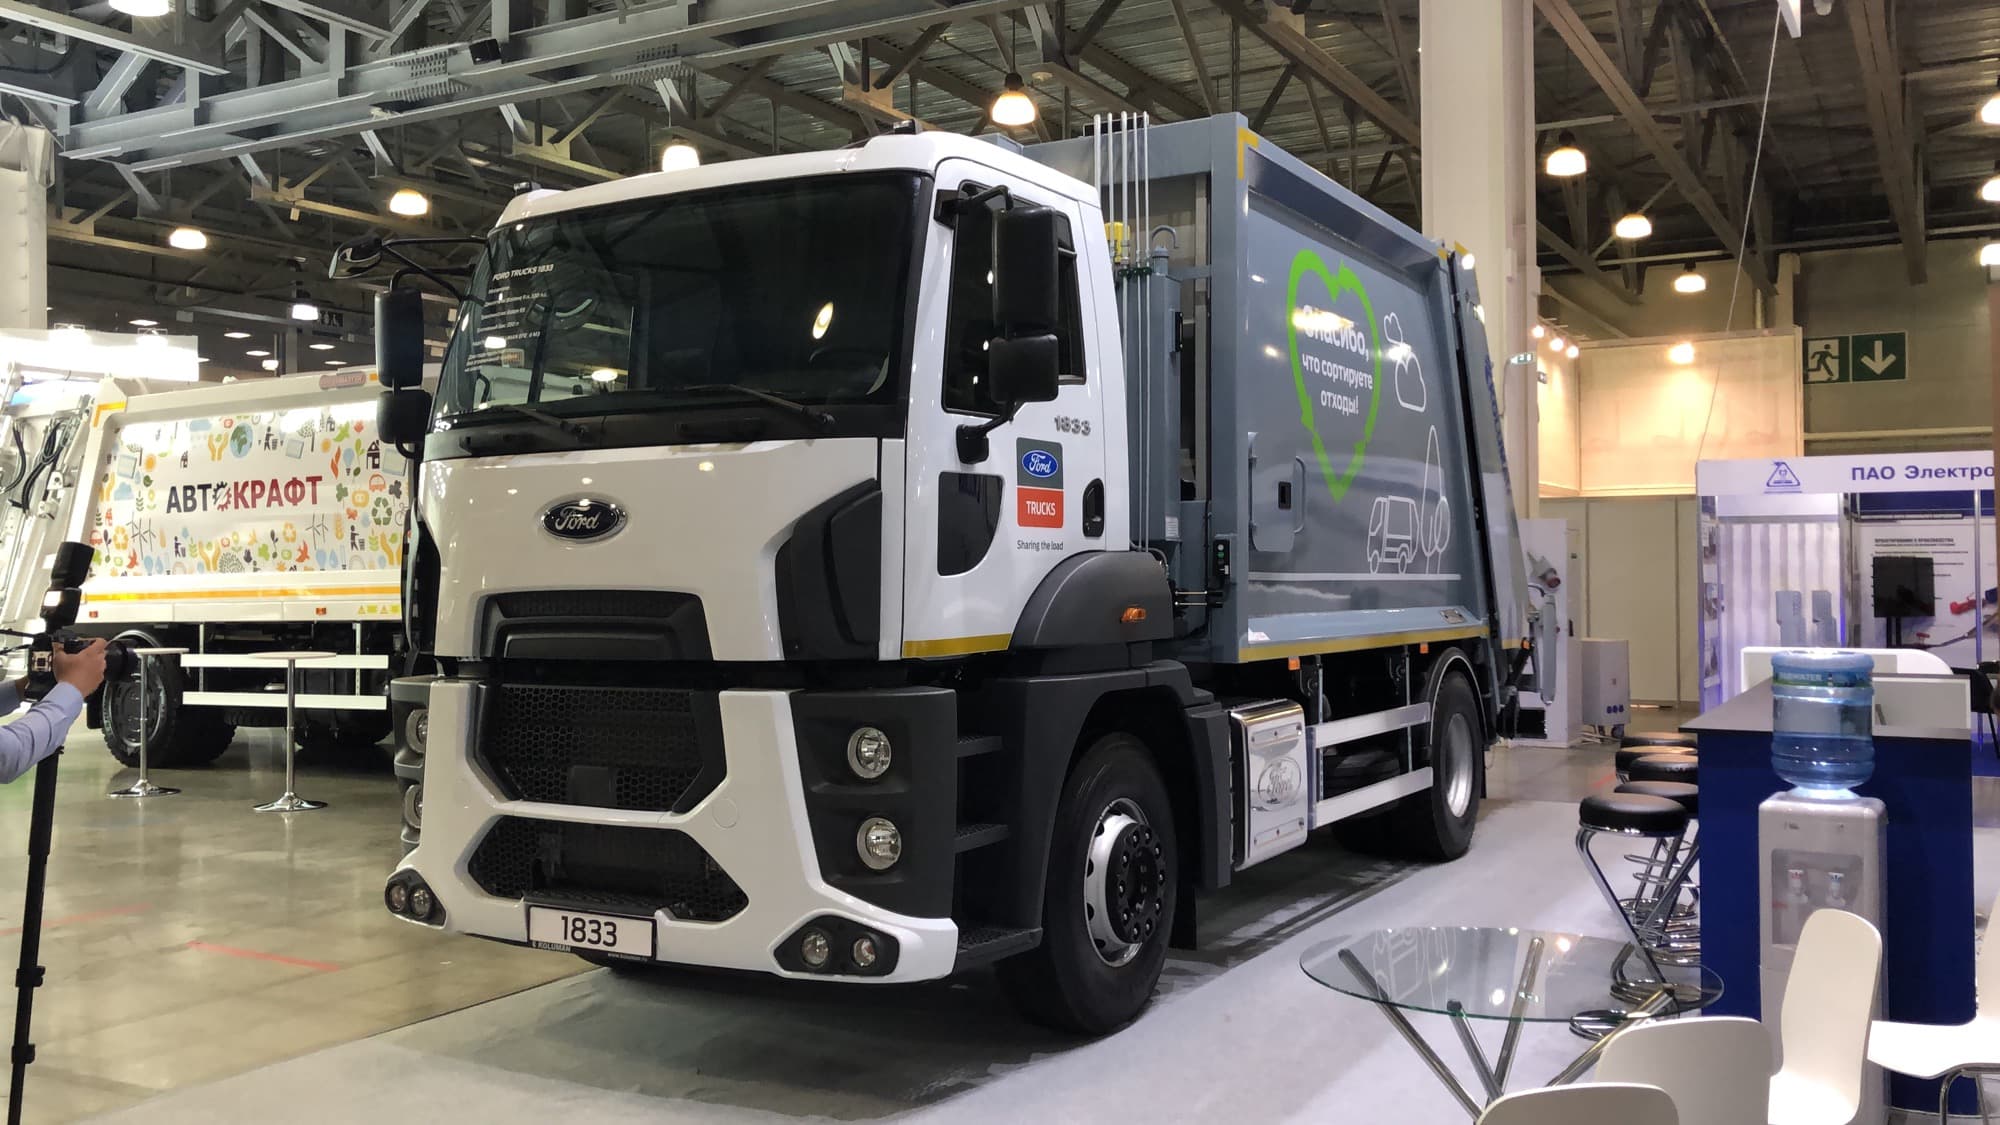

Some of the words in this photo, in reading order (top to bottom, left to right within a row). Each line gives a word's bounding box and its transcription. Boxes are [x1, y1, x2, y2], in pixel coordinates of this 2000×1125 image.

[492, 271, 511, 281] FORD
[511, 266, 537, 277] TRUCKS
[1302, 353, 1320, 374] что
[1321, 360, 1373, 389] сортируете
[1320, 390, 1359, 417] отходы!
[1054, 415, 1091, 437] 1833
[1029, 453, 1052, 473] Ford
[1851, 466, 1896, 481] ПАО
[1904, 465, 1995, 480] Электро
[555, 506, 601, 530] Ford
[1026, 500, 1056, 516] TRUCKS
[1016, 539, 1040, 552] Sharing
[1040, 540, 1051, 550] the
[1050, 541, 1064, 551] load
[561, 915, 618, 947] 1833
[538, 942, 571, 952] KOLUMAN
